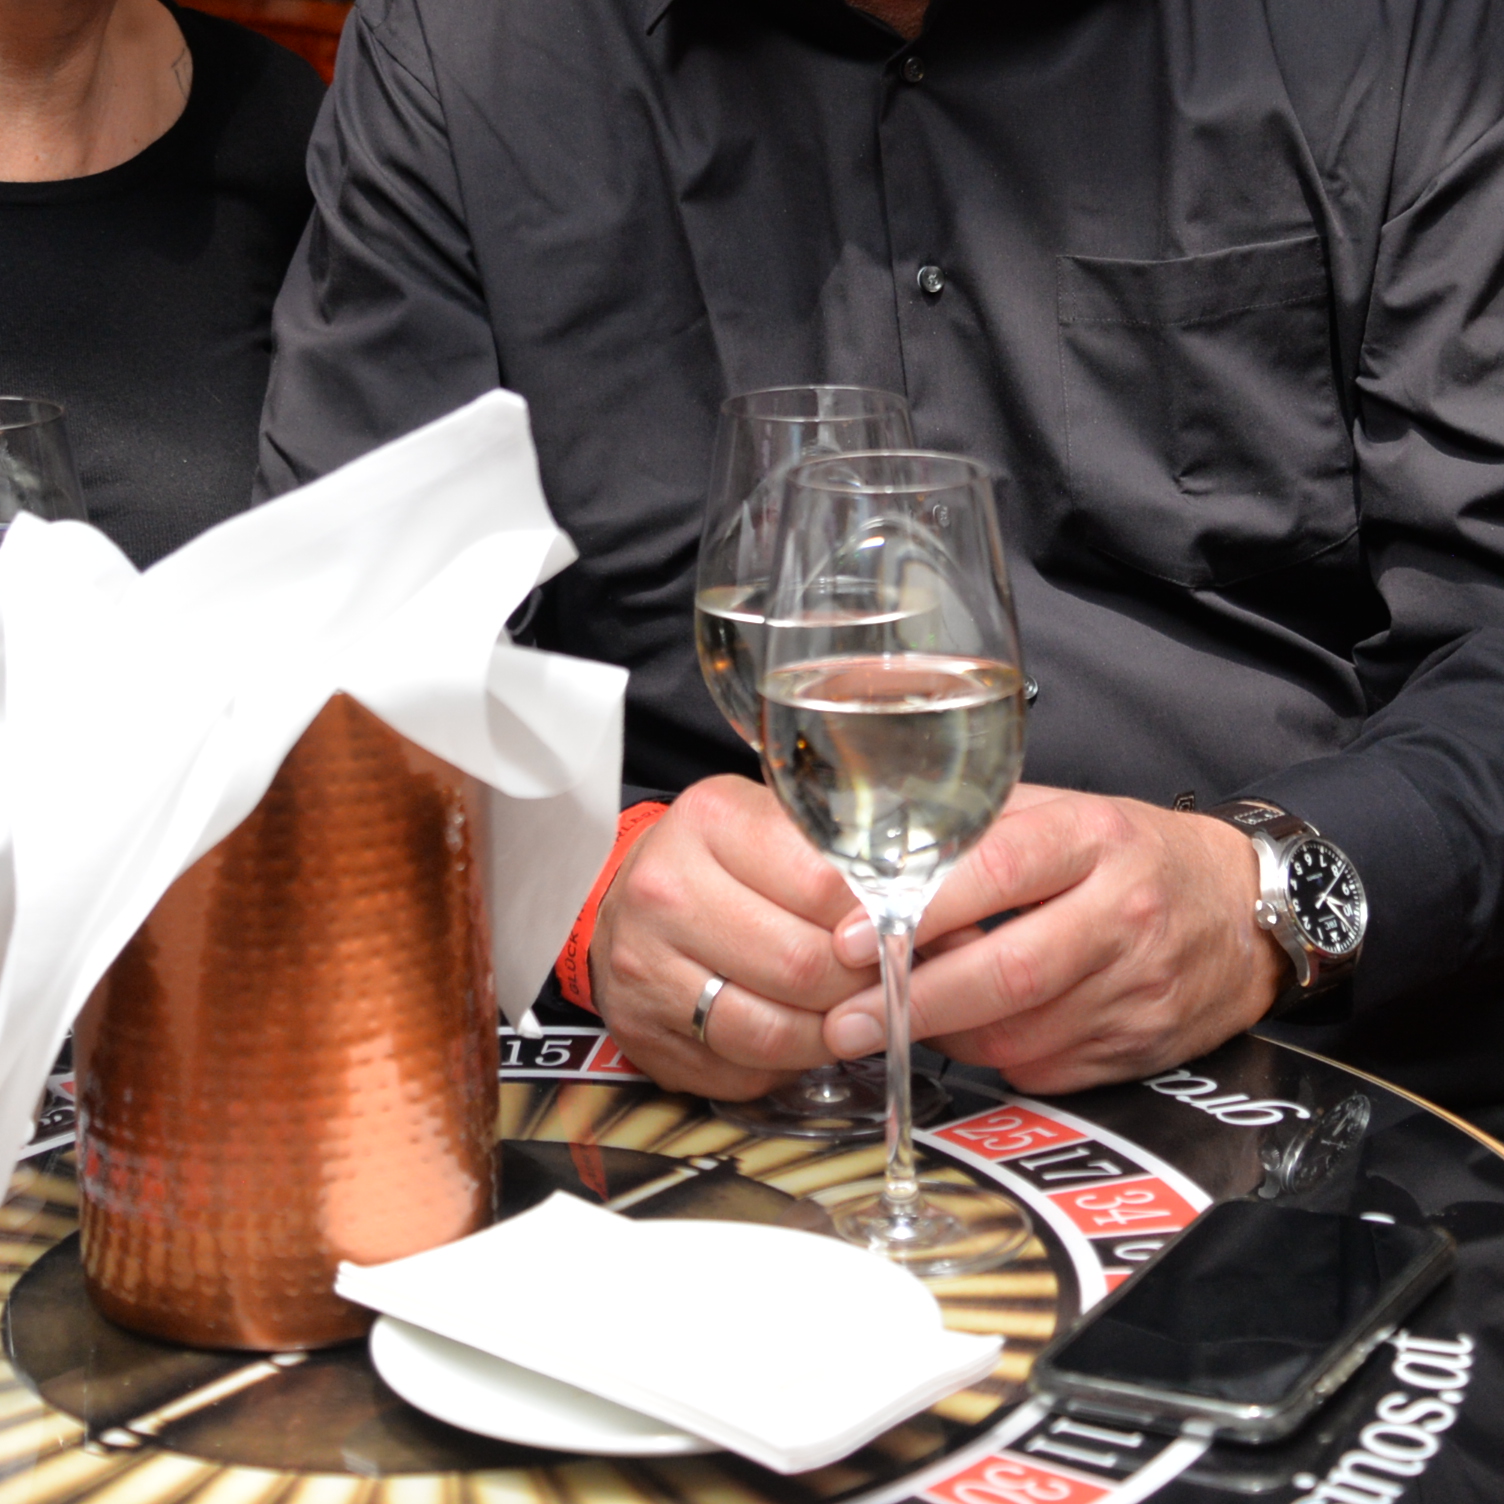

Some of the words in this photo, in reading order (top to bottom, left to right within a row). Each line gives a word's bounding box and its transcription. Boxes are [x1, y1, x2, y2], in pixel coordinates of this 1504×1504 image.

[1294, 862, 1303, 876] 5
[1303, 853, 1313, 867] 6
[1319, 854, 1327, 868] 7
[1341, 882, 1350, 896] 9
[1302, 916, 1311, 930] 2
[564, 930, 579, 996] GLÜCK
[500, 1038, 573, 1067] 15
[953, 1114, 1058, 1151] 25
[1019, 1146, 1123, 1181] 17
[1074, 1188, 1171, 1227] 34
[1290, 1328, 1475, 1504] inos.at
[1025, 1415, 1145, 1469] 11
